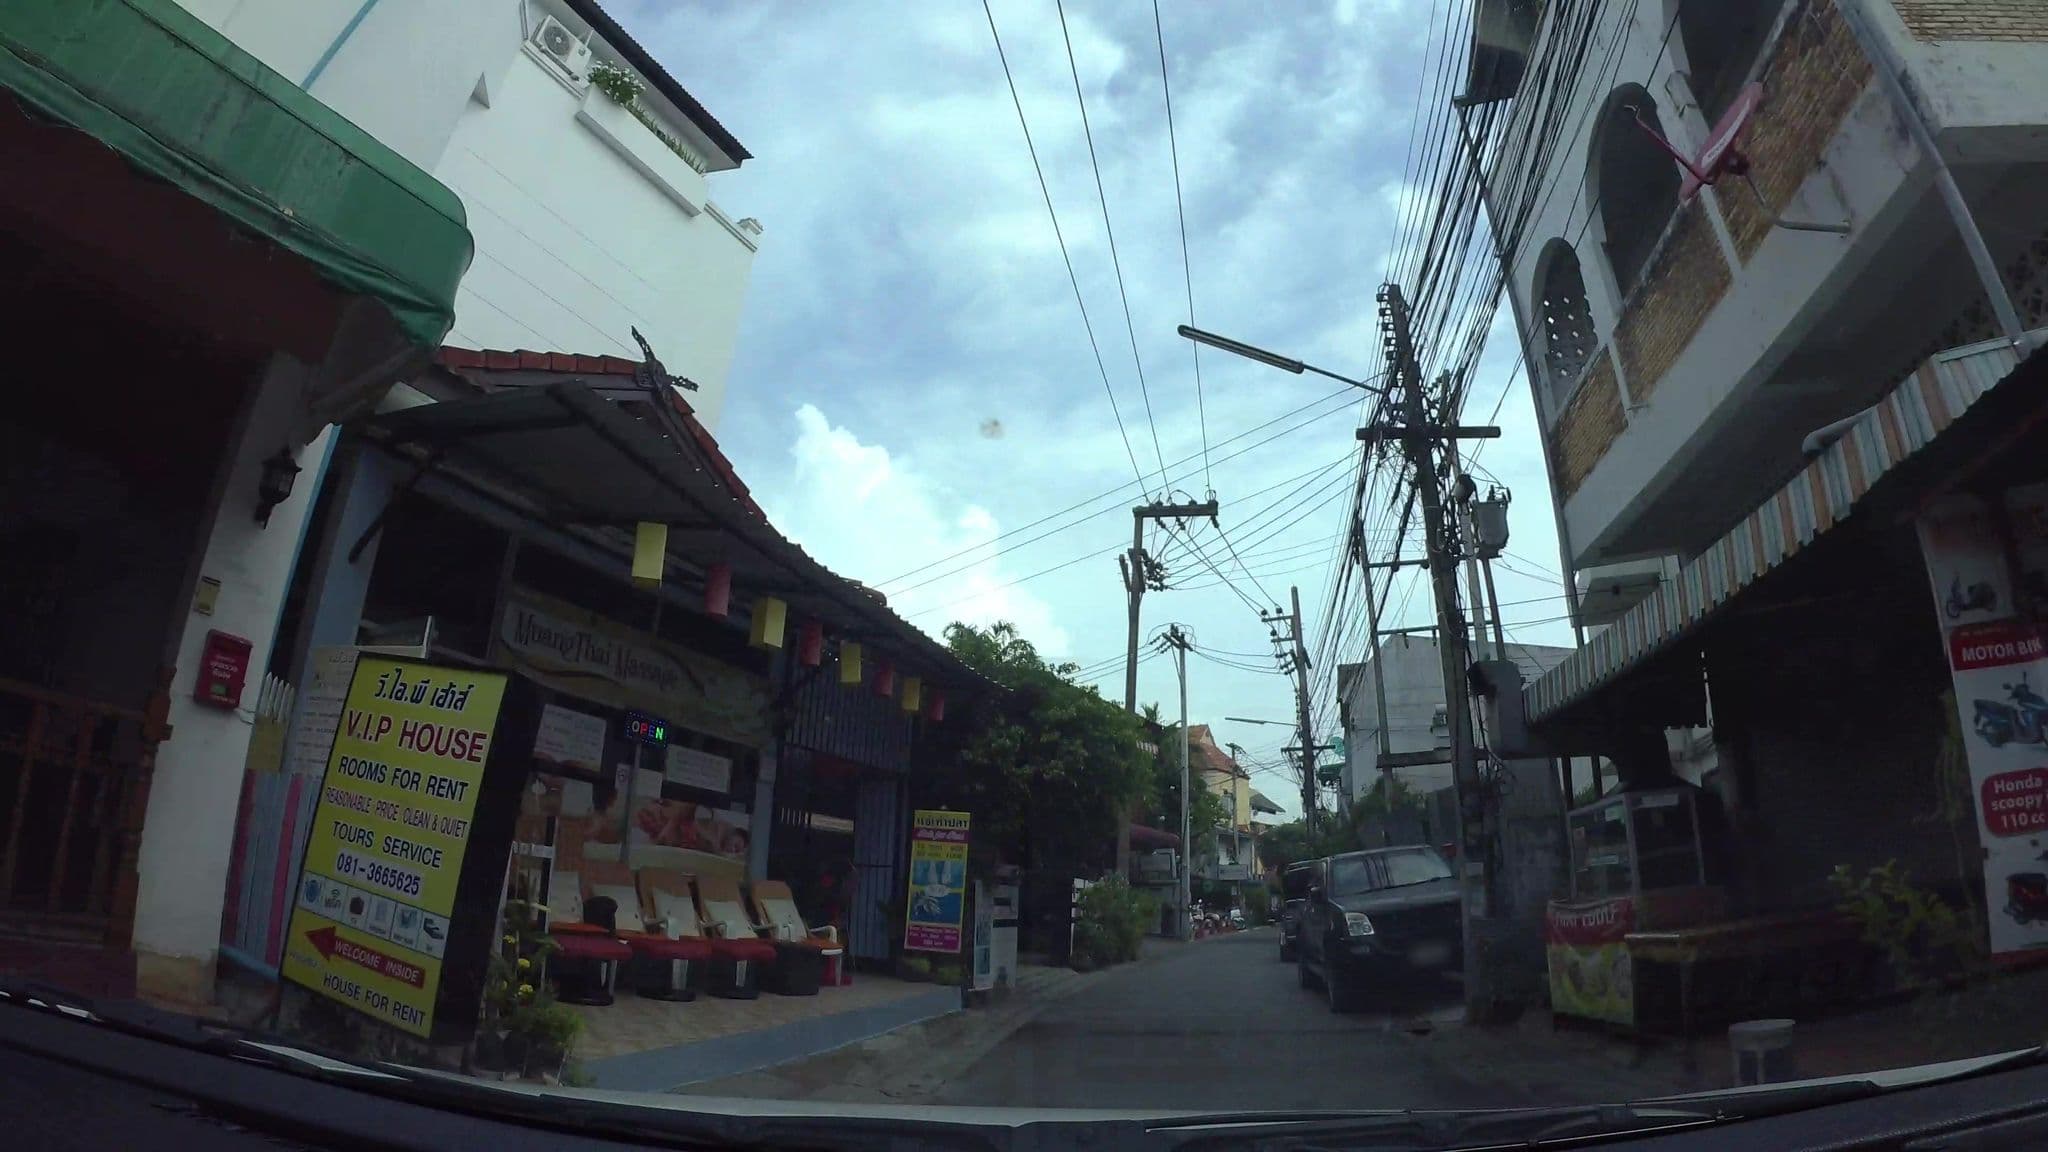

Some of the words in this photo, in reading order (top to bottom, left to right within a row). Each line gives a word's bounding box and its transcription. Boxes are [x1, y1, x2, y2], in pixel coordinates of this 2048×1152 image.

[1961, 642, 2016, 662] MOTOR
[347, 710, 393, 742] V.I.P
[398, 719, 488, 763] HOUSE
[631, 720, 665, 742] OPEN
[338, 756, 388, 784] ROOMS
[391, 767, 422, 792] FOR
[425, 775, 469, 802] RENT
[1993, 773, 2043, 794] Honda
[327, 787, 372, 814] REASONABLE
[375, 800, 400, 821] PRICE
[402, 807, 432, 829] CLEAN
[431, 814, 438, 831] &
[440, 816, 467, 839] QUIET
[1991, 793, 2043, 812] scoopy
[2001, 812, 2029, 829] 110
[2031, 813, 2045, 824] cc
[333, 821, 375, 848] TOURS
[382, 835, 443, 868] SERVICE
[336, 852, 421, 895] 081-3665625
[335, 940, 380, 968] WELCOME
[385, 960, 421, 983] INSIDE
[323, 974, 361, 1000] HOUSE
[364, 989, 390, 1014] FOR
[392, 1001, 426, 1027] RENT
